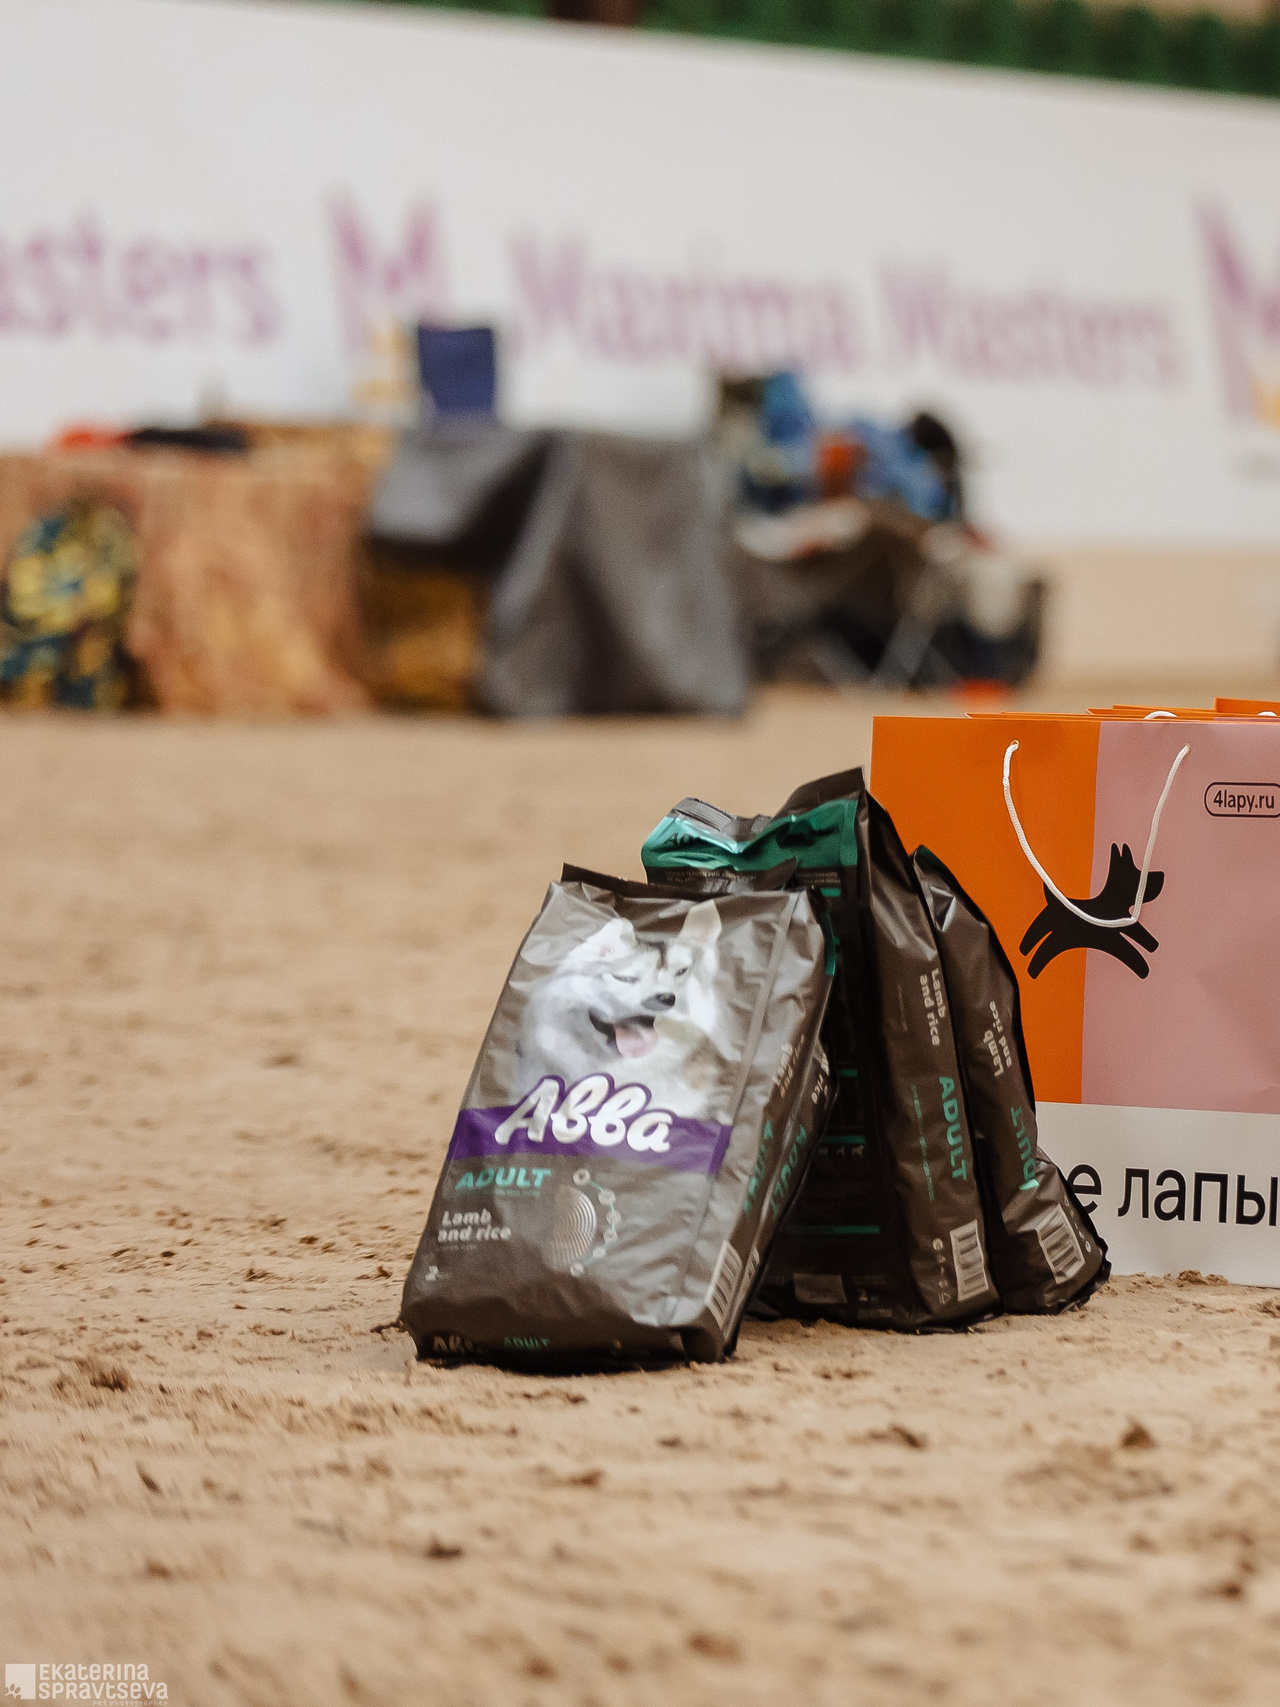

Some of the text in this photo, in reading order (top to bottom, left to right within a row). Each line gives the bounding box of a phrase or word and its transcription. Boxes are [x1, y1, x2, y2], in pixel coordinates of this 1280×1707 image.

[0, 208, 285, 350] sters
[1212, 788, 1275, 813] 4lapy.ru
[920, 974, 940, 1047] and rice
[931, 967, 946, 1018] Lamb
[983, 1029, 1004, 1078] Lamb
[988, 1000, 1013, 1069] and rice
[939, 1076, 968, 1181] ADULT
[1010, 1106, 1040, 1191] ADULT
[454, 1166, 552, 1190] ADULT
[1066, 1164, 1279, 1227] е лапы
[437, 1224, 512, 1243] and rice
[442, 1208, 492, 1228] Lamb
